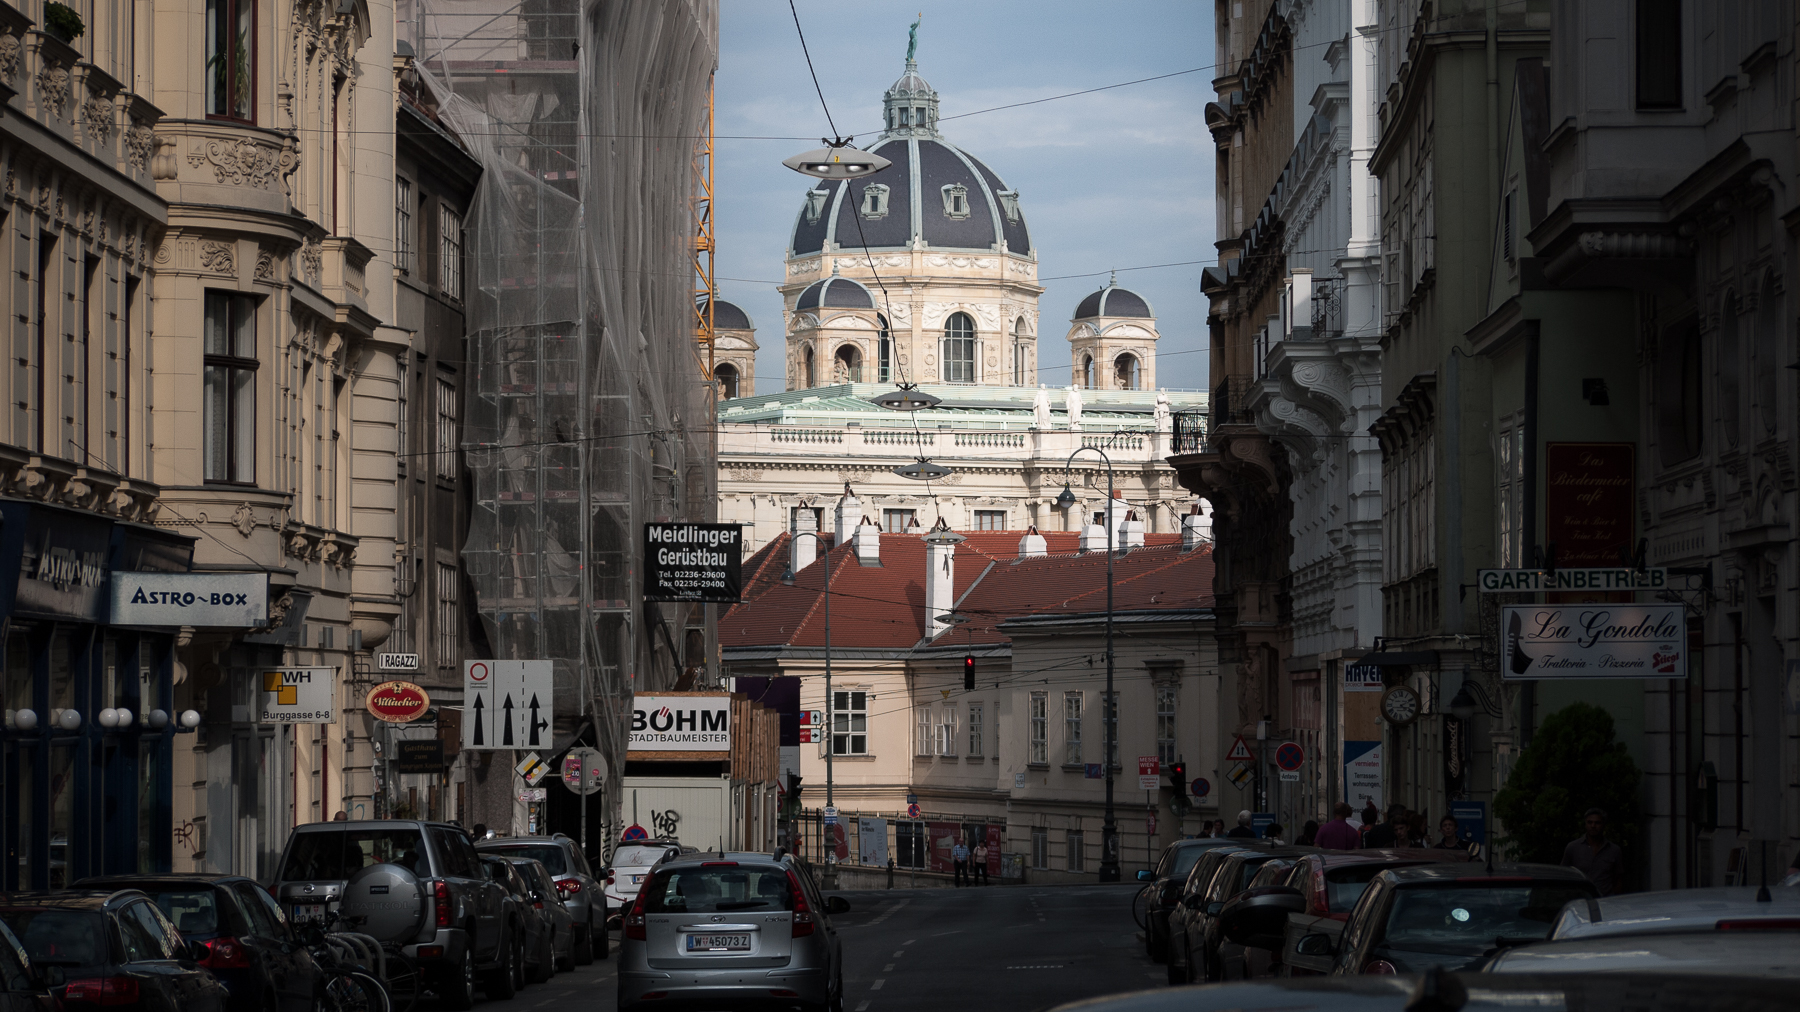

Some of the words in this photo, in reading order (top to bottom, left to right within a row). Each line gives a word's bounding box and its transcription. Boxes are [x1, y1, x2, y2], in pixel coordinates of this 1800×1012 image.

[1577, 450, 1605, 467] Das
[1550, 470, 1631, 486] Biedermeier
[1576, 487, 1604, 506] café
[648, 525, 738, 548] Meidlinger
[657, 547, 727, 566] Gerüstbau
[658, 570, 673, 578] Tel.
[674, 570, 726, 579] 02236-29600
[658, 579, 672, 588] Fax
[674, 579, 725, 588] 02236-29400
[1527, 610, 1572, 639] La
[1577, 610, 1678, 649] Gondola
[385, 655, 417, 668] RAGAZZI
[1537, 654, 1587, 669] Trattoria
[1598, 653, 1645, 669] Pizzeria
[1652, 652, 1680, 669] Stiegl
[283, 671, 311, 683] WH
[373, 696, 422, 707] Villacher
[262, 711, 313, 721] Burggasse
[315, 710, 330, 719] 6-8
[630, 706, 728, 732] BÖHM
[628, 733, 728, 743] STADTBAUMEISTER
[404, 743, 437, 753] Gasthaus
[1354, 760, 1380, 768] vermieten
[1352, 780, 1382, 789] wohnungen,
[304, 905, 312, 914] W
[350, 900, 414, 911] PATROL
[694, 936, 702, 947] W
[708, 935, 740, 947] 45073
[741, 936, 748, 947] Z
